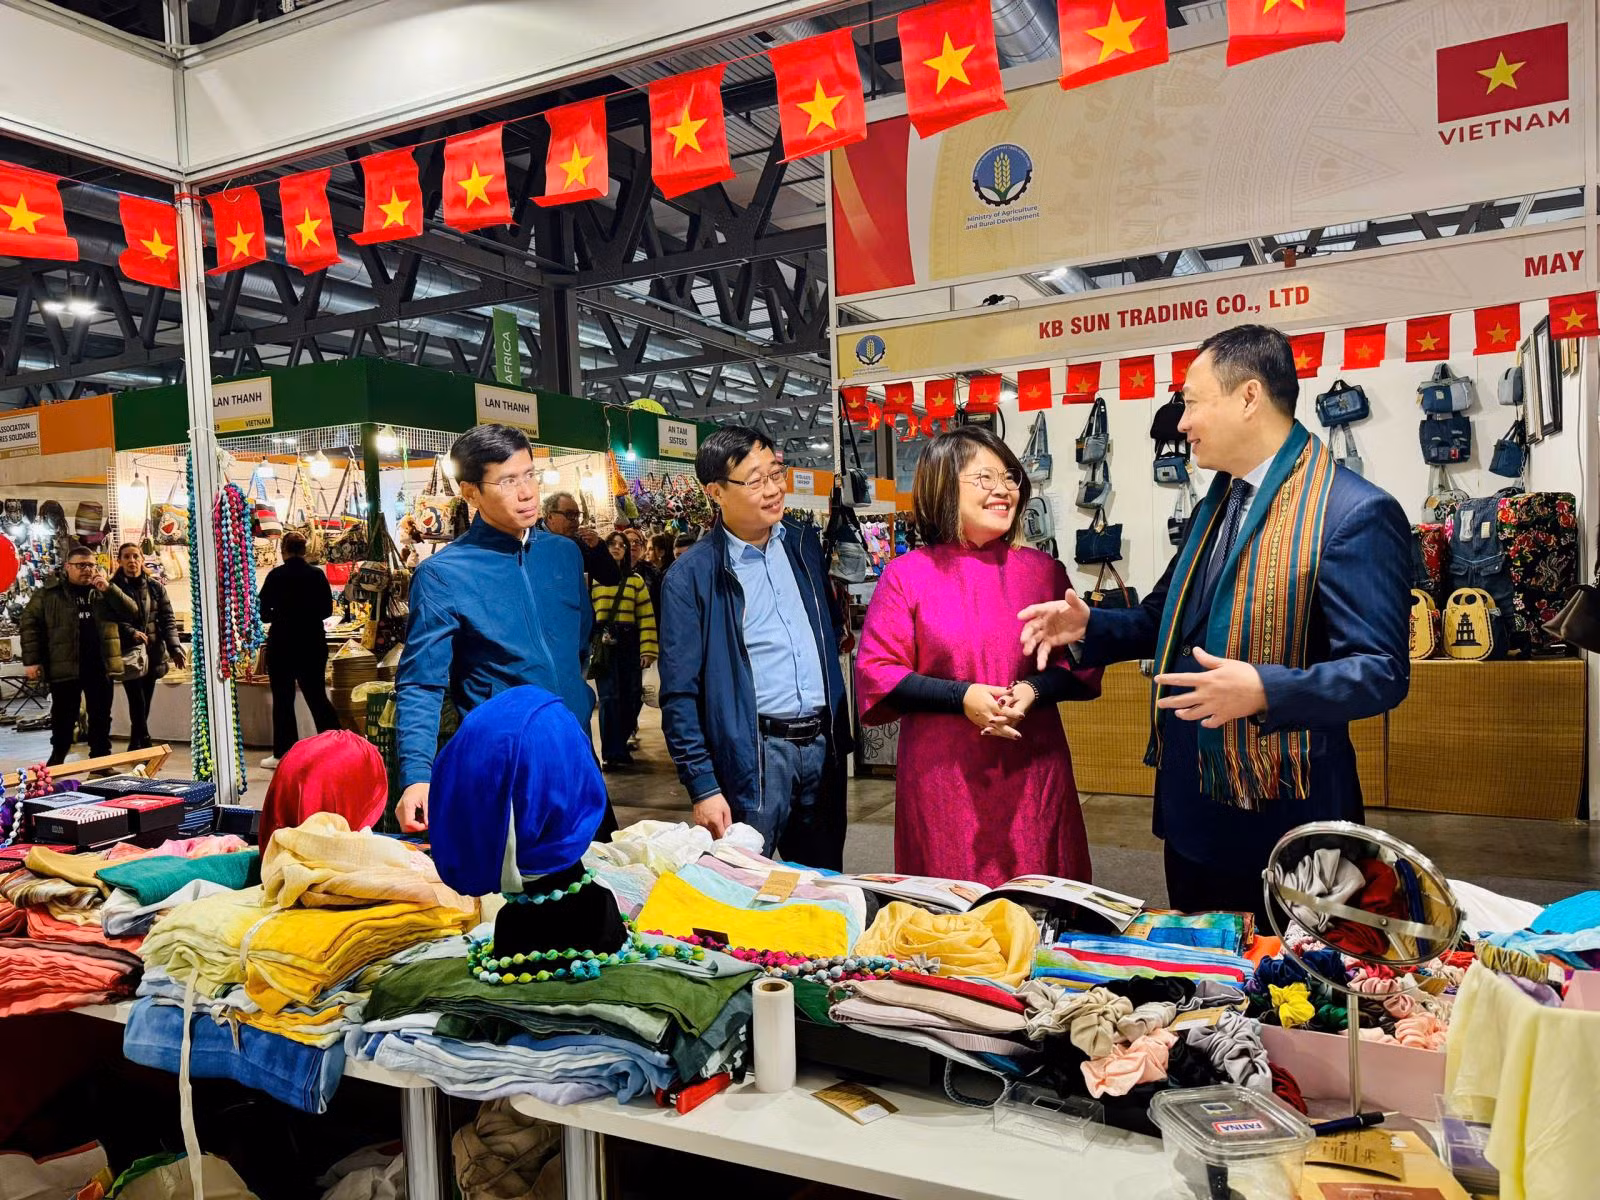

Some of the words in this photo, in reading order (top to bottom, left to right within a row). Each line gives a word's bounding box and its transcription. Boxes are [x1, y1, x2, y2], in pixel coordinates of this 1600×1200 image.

[1438, 107, 1570, 146] VIETNAM
[965, 222, 978, 230] and
[978, 219, 996, 228] Rural
[996, 212, 1040, 225] Development
[967, 213, 993, 222] Ministry
[1001, 205, 1038, 217] Agriculture
[1524, 250, 1584, 278] MAY
[1039, 319, 1064, 339] KB
[1070, 312, 1110, 335] SUN
[1117, 299, 1208, 329] TRADING
[1216, 293, 1261, 315] CO.,
[1269, 285, 1310, 308] LTD
[502, 331, 514, 384] AFRICA
[213, 396, 230, 408] LAN
[231, 392, 262, 405] THANH
[484, 397, 501, 409] LAN
[502, 401, 530, 414] THANH
[0, 422, 30, 434] SSOCIATION
[245, 418, 271, 427] VIETNAM
[668, 425, 676, 434] AN
[677, 427, 688, 436] TAM
[8, 431, 37, 442] SOLIDAIRES
[668, 436, 688, 446] SISTERS
